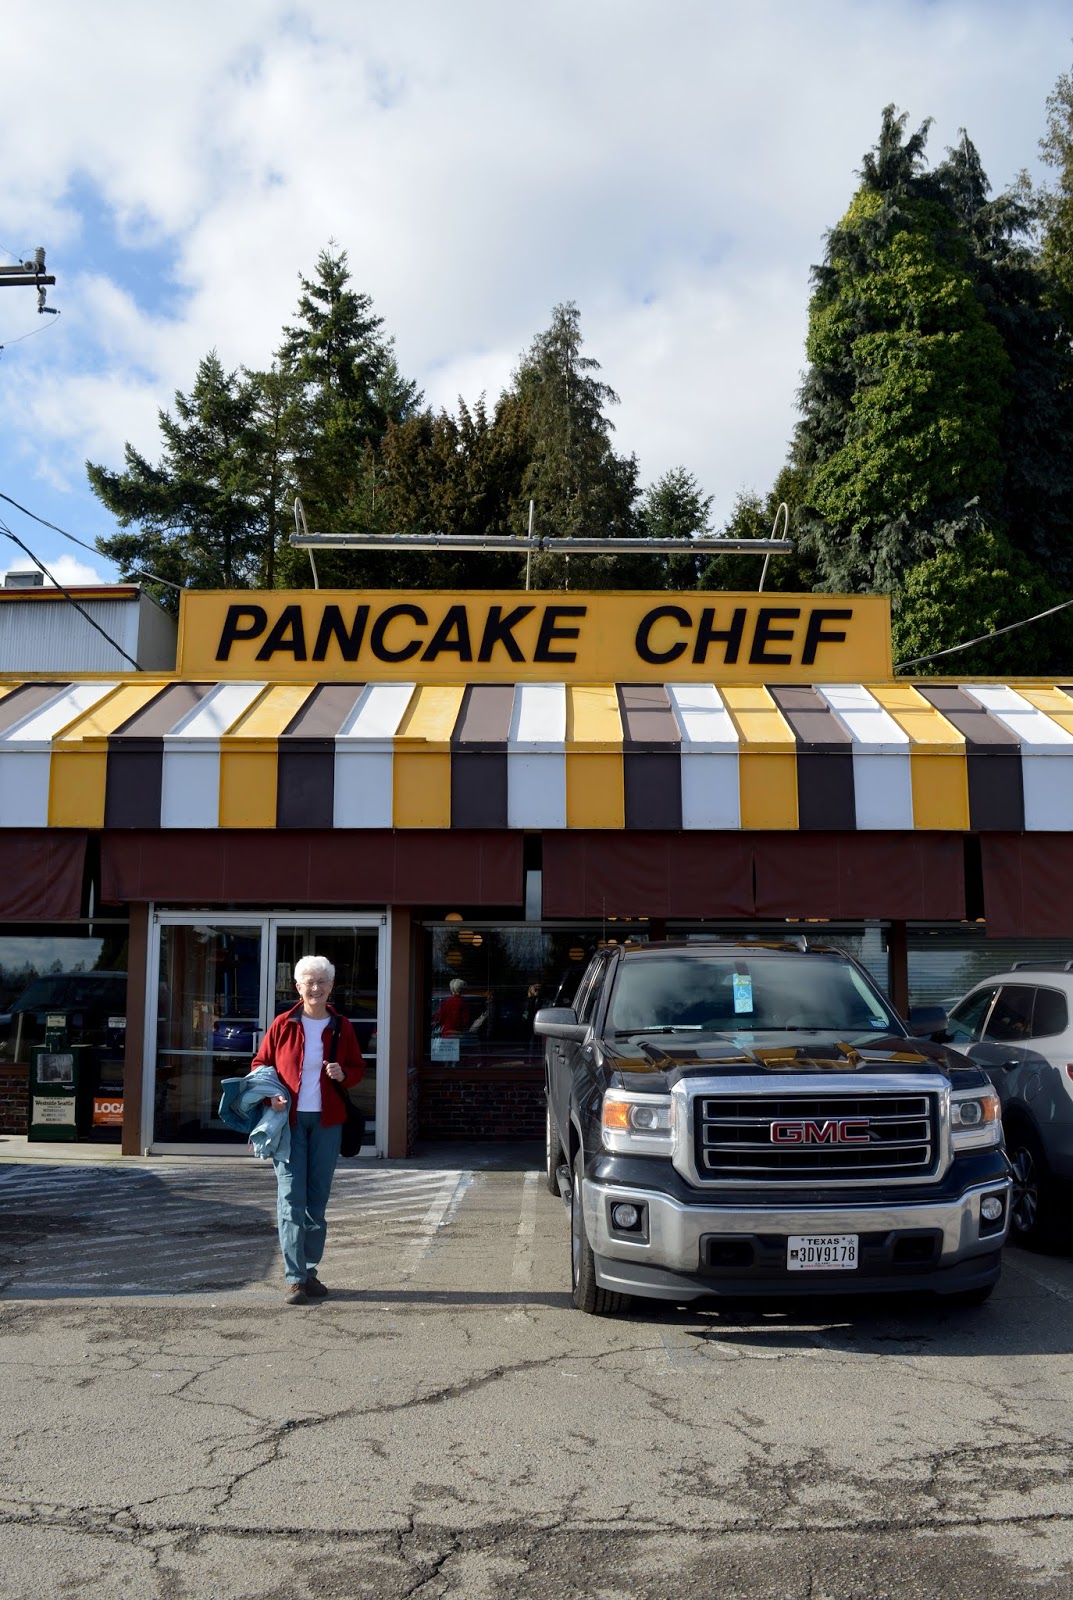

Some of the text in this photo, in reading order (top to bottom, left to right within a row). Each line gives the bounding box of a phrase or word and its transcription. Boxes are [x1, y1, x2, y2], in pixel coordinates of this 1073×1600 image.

[214, 603, 854, 664] PANCAKE CHEF
[770, 1120, 871, 1144] GMC
[799, 1246, 855, 1262] 3DV9178
